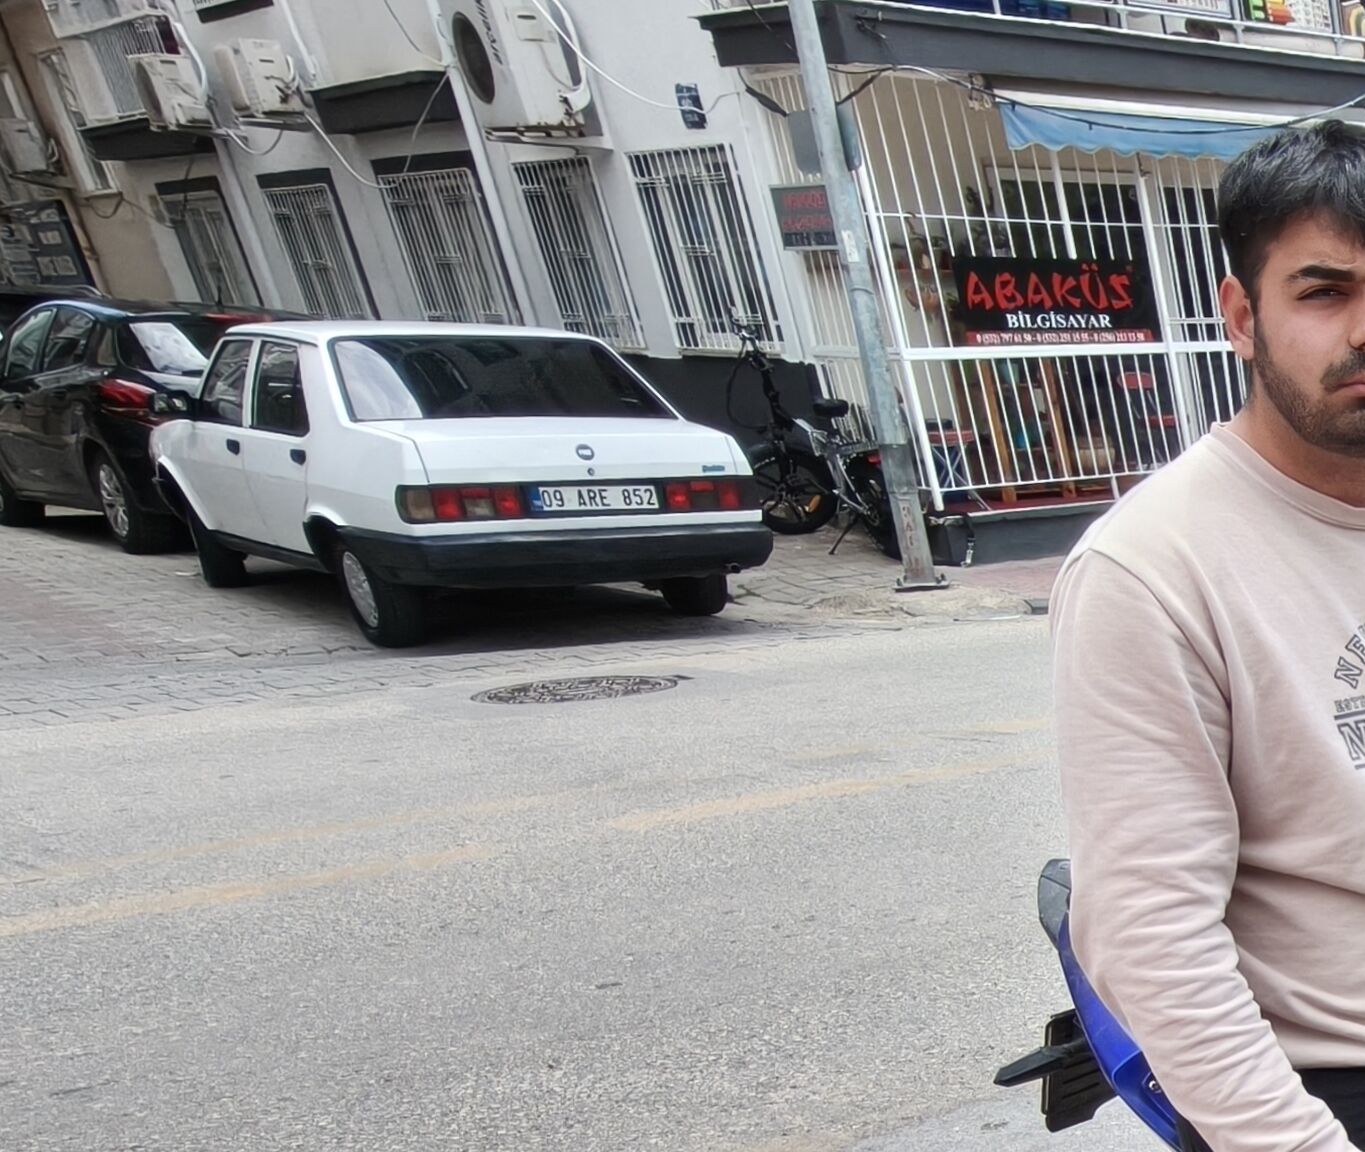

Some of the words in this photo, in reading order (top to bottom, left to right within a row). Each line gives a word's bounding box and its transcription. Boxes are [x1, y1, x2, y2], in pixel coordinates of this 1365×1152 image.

[966, 263, 1134, 311] ABAKÜS
[1006, 311, 1112, 329] BİLGİSAYAR
[541, 489, 565, 508] 09
[577, 488, 611, 508] ARE
[622, 487, 656, 507] 852
